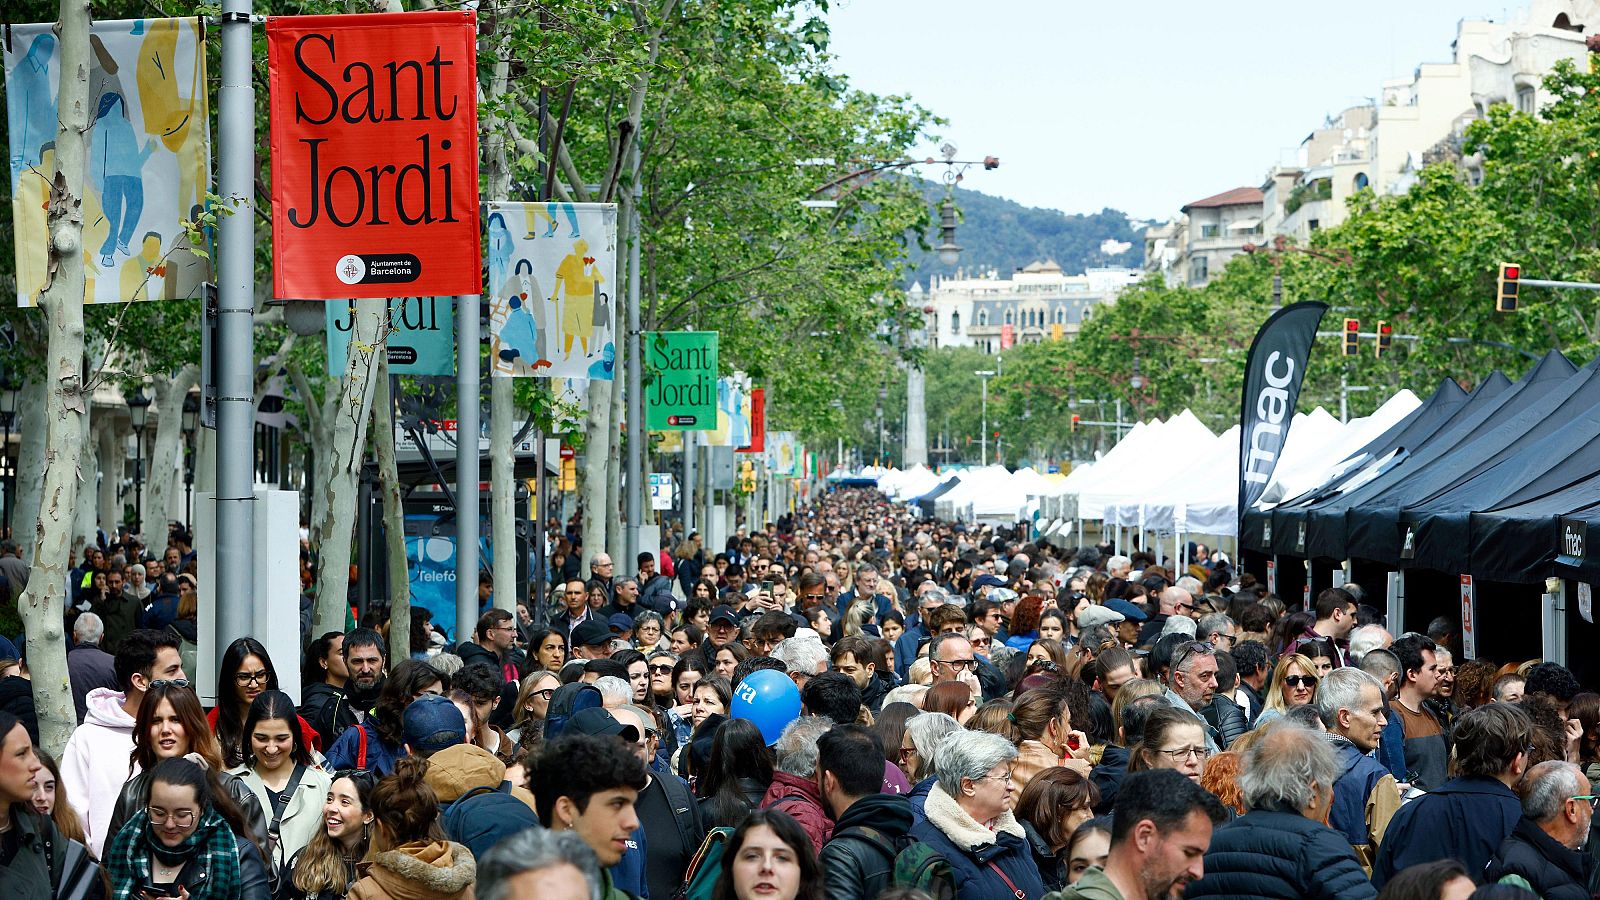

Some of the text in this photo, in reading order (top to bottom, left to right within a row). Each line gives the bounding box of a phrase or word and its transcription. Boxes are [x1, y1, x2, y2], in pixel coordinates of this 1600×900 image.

[294, 33, 459, 125] Sant
[287, 133, 460, 229] Jordi
[370, 260, 403, 268] Ajuntament
[370, 267, 412, 276] Barcelona
[334, 297, 440, 332] Jrdi
[653, 338, 712, 371] Sant
[650, 374, 710, 407] Jordi
[1244, 350, 1295, 484] fnac
[1565, 525, 1582, 557] fnac
